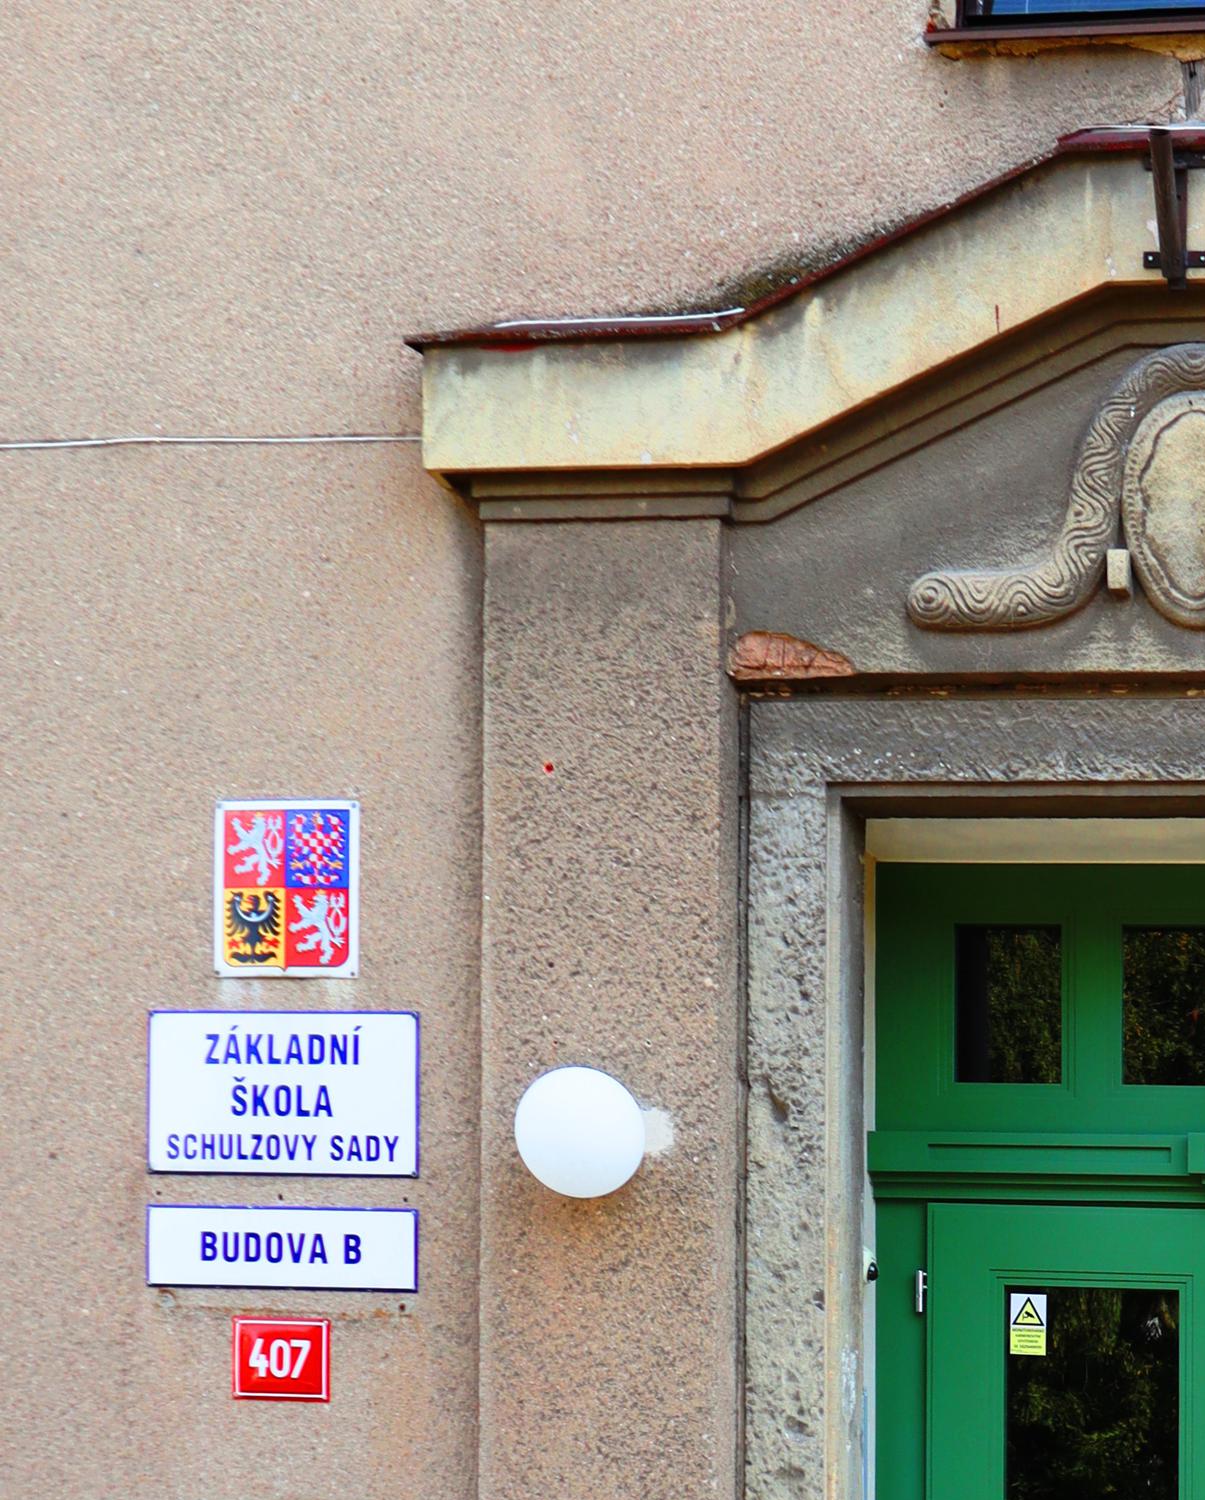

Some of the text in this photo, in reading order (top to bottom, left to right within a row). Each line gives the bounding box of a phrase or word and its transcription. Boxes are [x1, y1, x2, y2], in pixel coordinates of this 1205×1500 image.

[205, 1025, 363, 1065] ZÁKLADNÍ
[231, 1076, 334, 1117] ŠKOLA
[166, 1134, 400, 1162] SCHULZOVY SADY
[200, 1231, 362, 1265] BUDOVA B
[248, 1338, 311, 1379] 407
